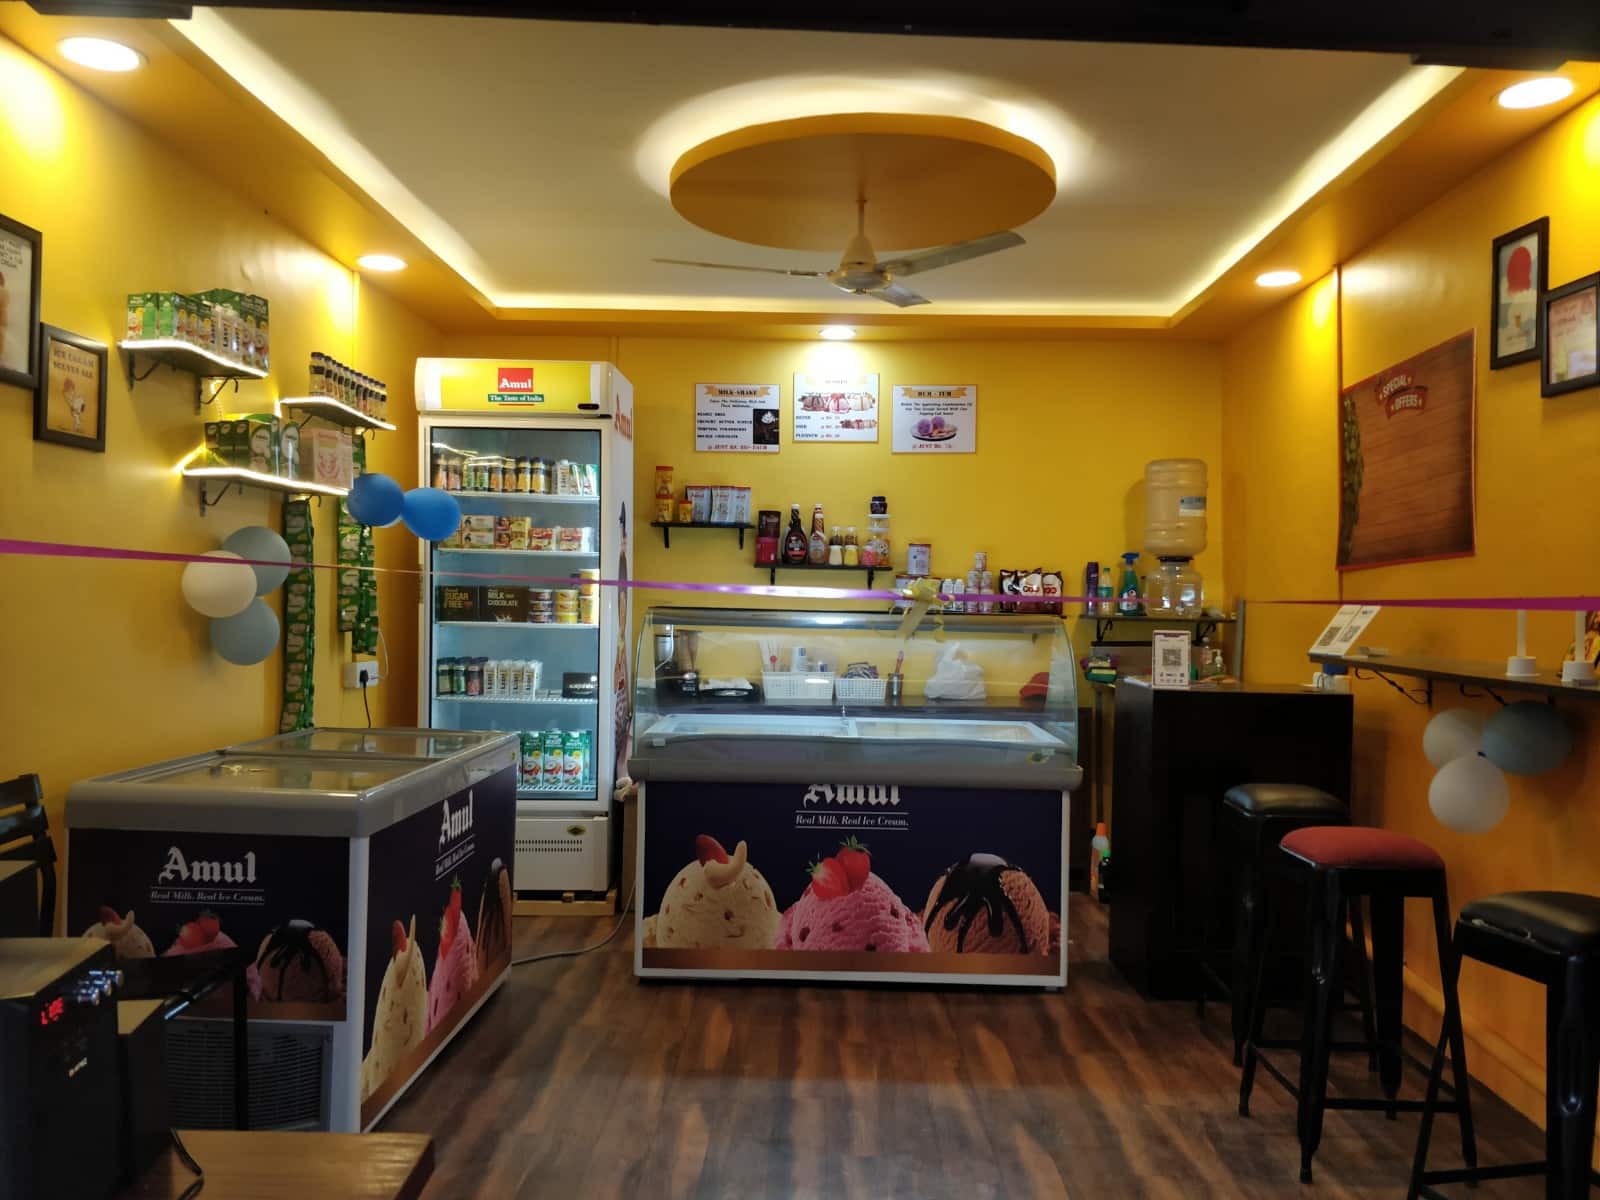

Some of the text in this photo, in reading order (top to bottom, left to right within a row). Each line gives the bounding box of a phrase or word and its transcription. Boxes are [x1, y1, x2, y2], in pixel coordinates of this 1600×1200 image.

[499, 377, 532, 389] Amul
[445, 592, 469, 600] SUGAR
[438, 789, 473, 854] Amul
[796, 815, 909, 827] Real Milk. Real Ice Cream.
[158, 846, 256, 884] Amul
[152, 890, 170, 899] Real
[197, 891, 217, 900] Real
[219, 891, 232, 900] Ice
